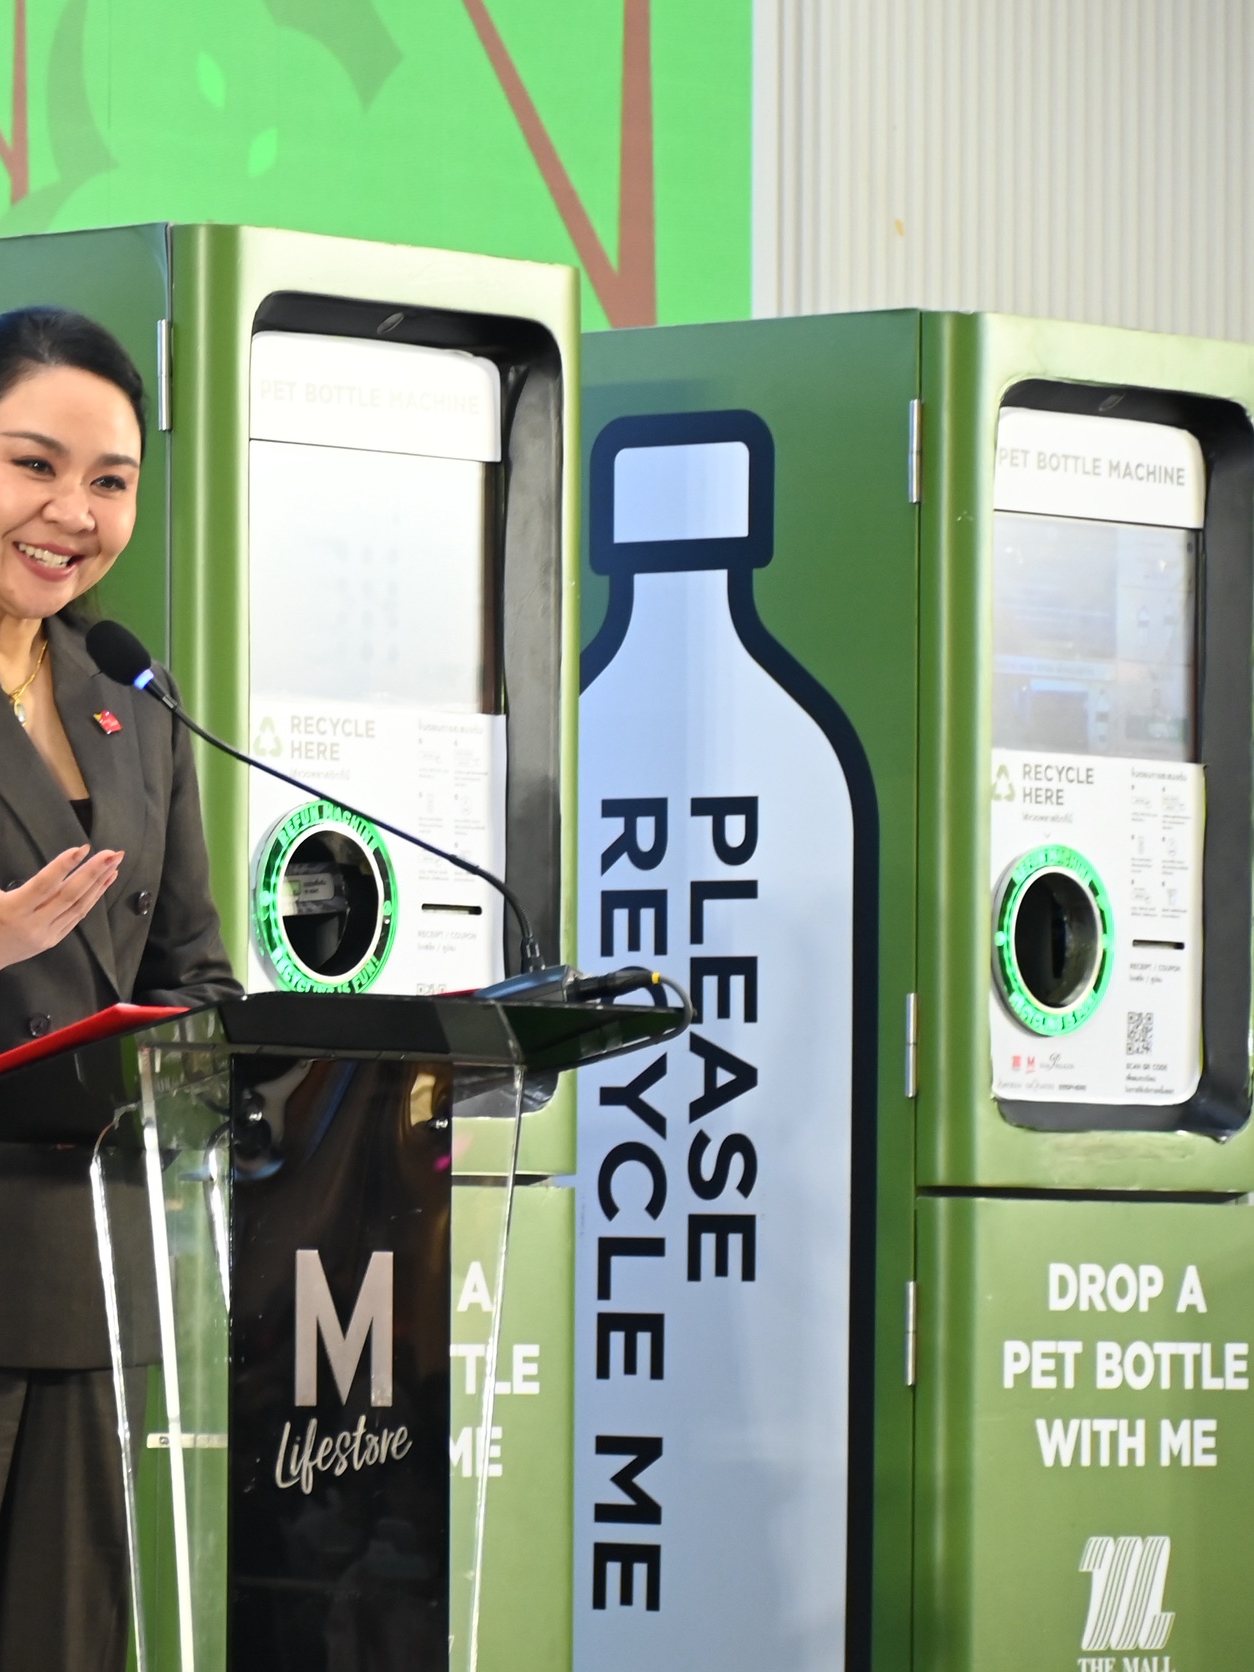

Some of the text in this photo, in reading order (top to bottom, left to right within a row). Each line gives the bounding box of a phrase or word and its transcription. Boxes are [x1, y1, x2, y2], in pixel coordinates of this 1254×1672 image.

[260, 379, 480, 416] PET BOTTLE MACHINE
[998, 447, 1185, 487] PET BOTTLE MACHINE
[290, 714, 376, 739] RECYCLE
[290, 739, 340, 762] HERE
[1022, 763, 1095, 785] RECYCLE
[1022, 787, 1065, 806] HERE
[689, 795, 759, 1283] PLEASE
[456, 1260, 494, 1313] A
[1048, 1262, 1208, 1314] DROP A
[294, 1248, 394, 1408] M
[1002, 1339, 1249, 1391] PET BOTTLE
[274, 1414, 413, 1495] Lifestore
[1035, 1418, 1218, 1468] WITH ME
[591, 1434, 664, 1612] ME
[1077, 1656, 1116, 1672] THE
